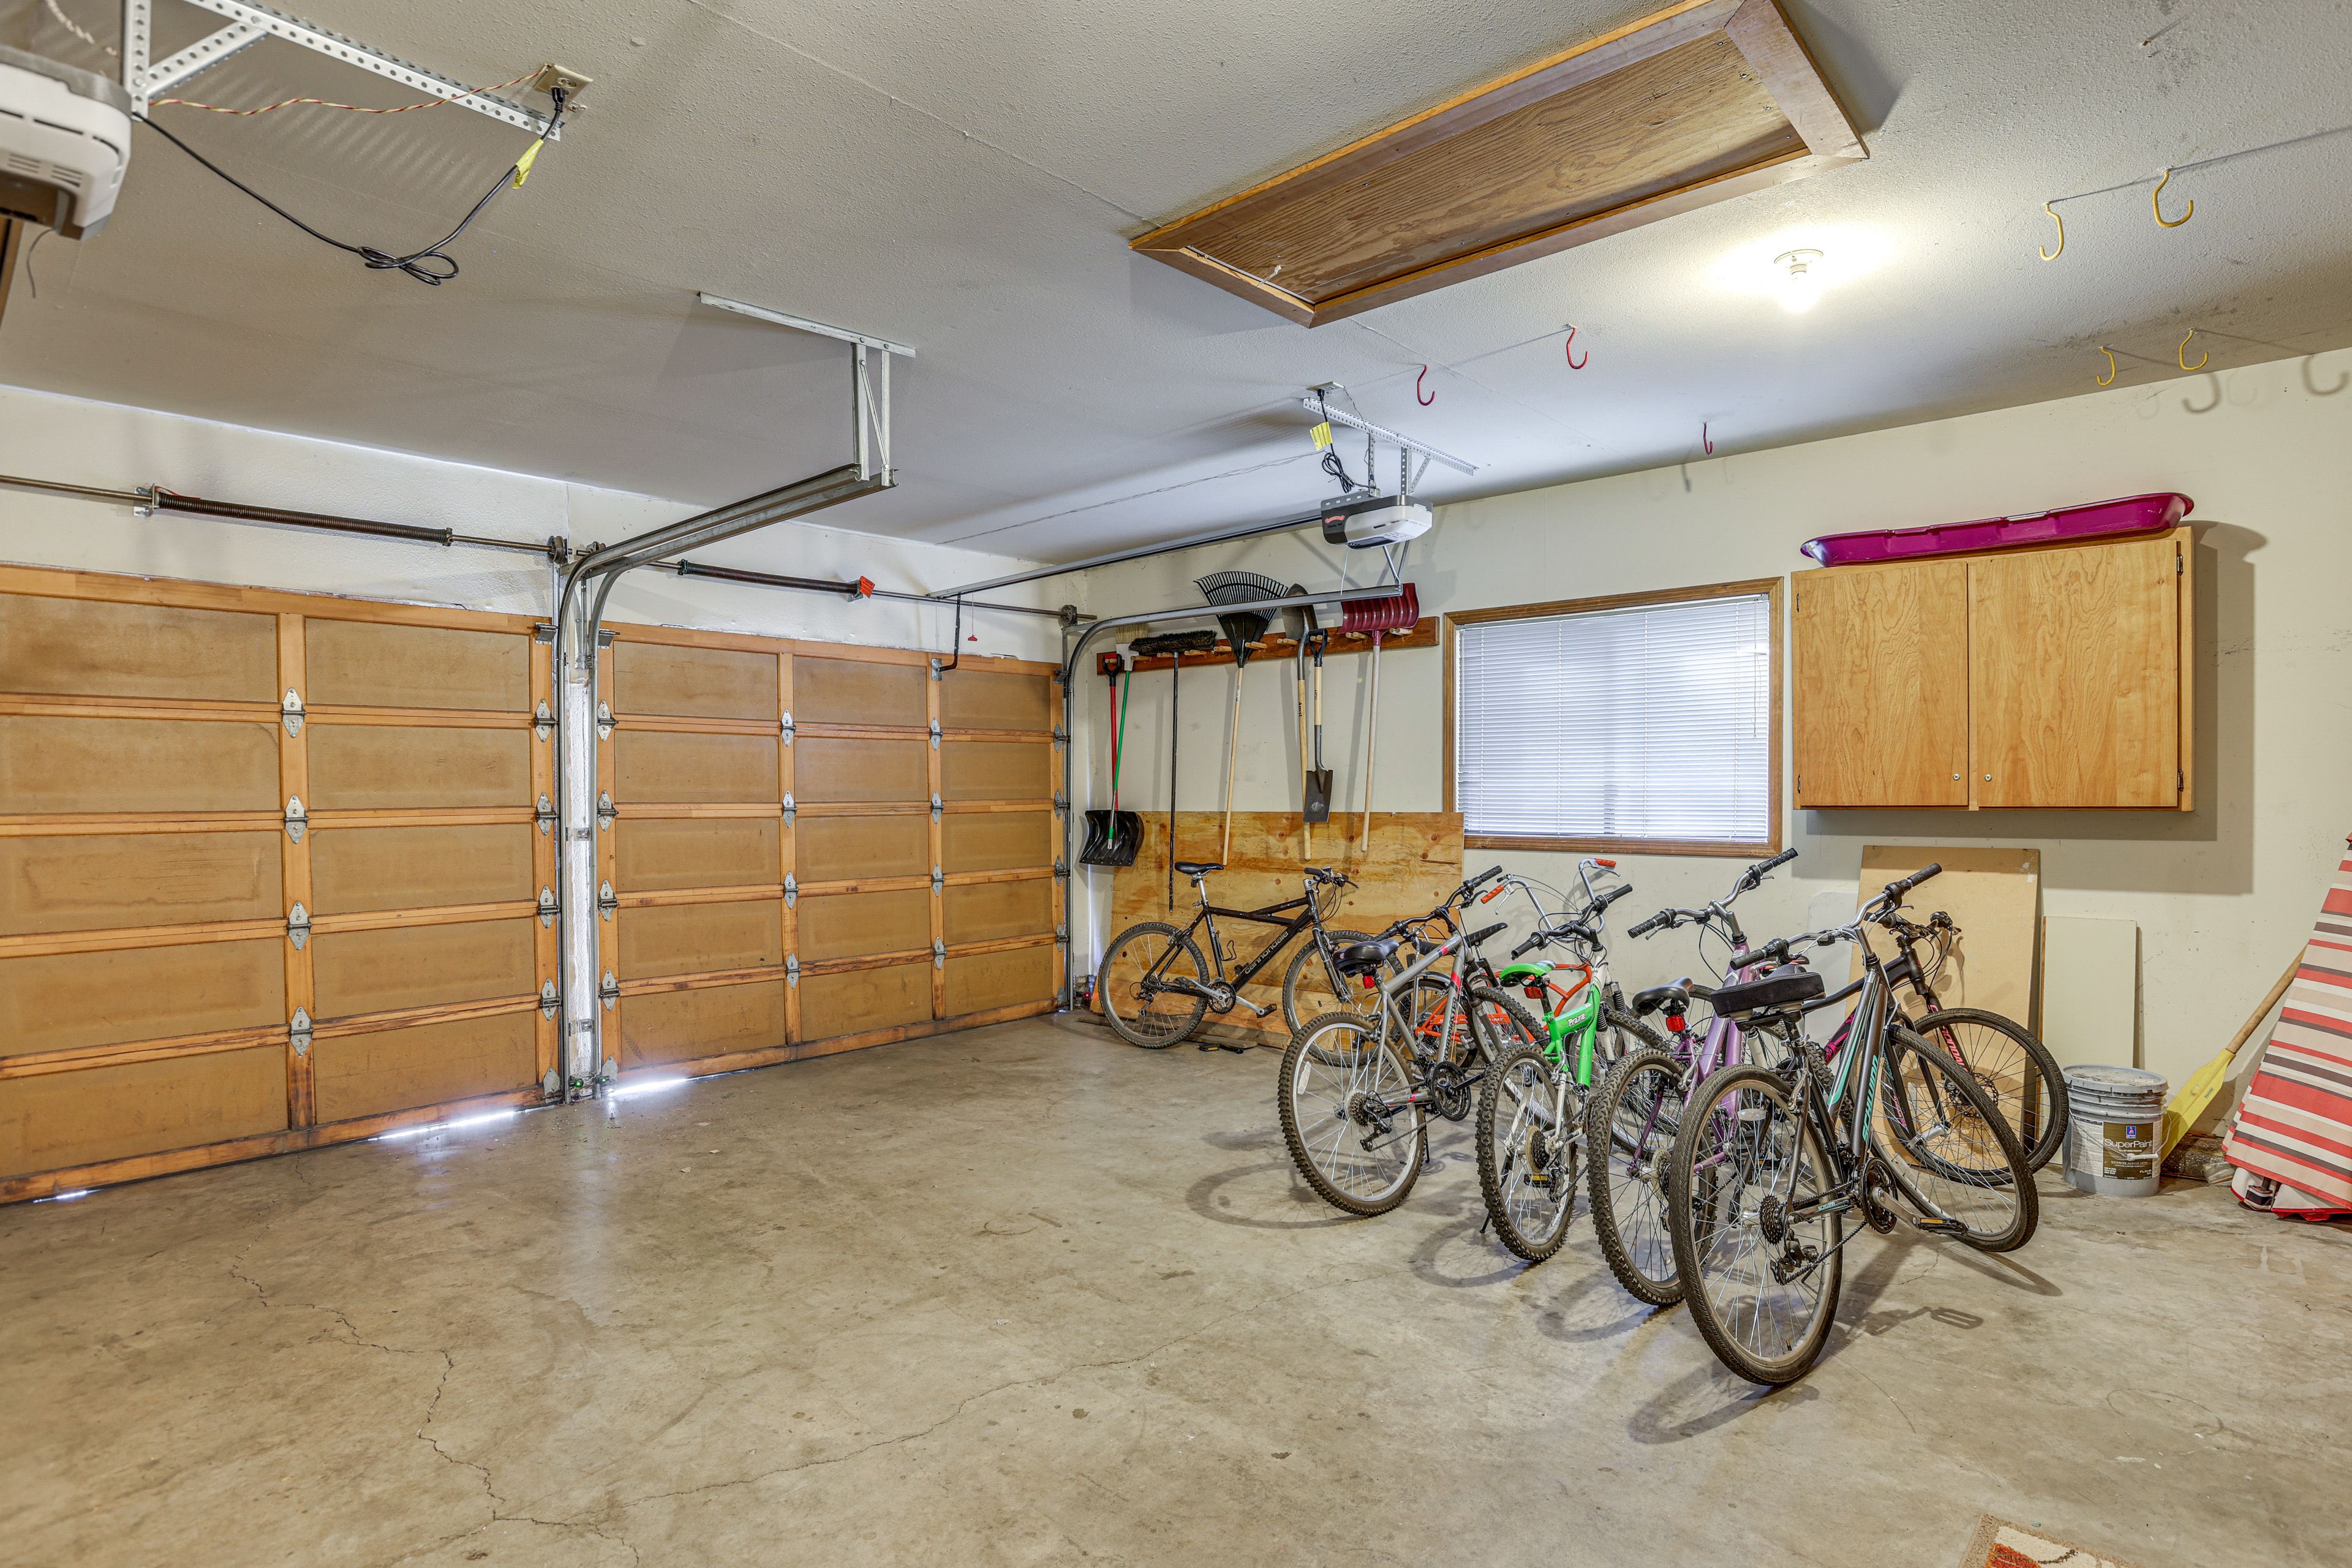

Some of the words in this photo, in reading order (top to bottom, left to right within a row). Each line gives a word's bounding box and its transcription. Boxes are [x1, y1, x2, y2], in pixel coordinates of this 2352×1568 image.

[1245, 931, 1289, 974] cannondale
[1862, 1055, 1879, 1143] SCHWINN
[2104, 1139, 2152, 1149] SuperPaint
